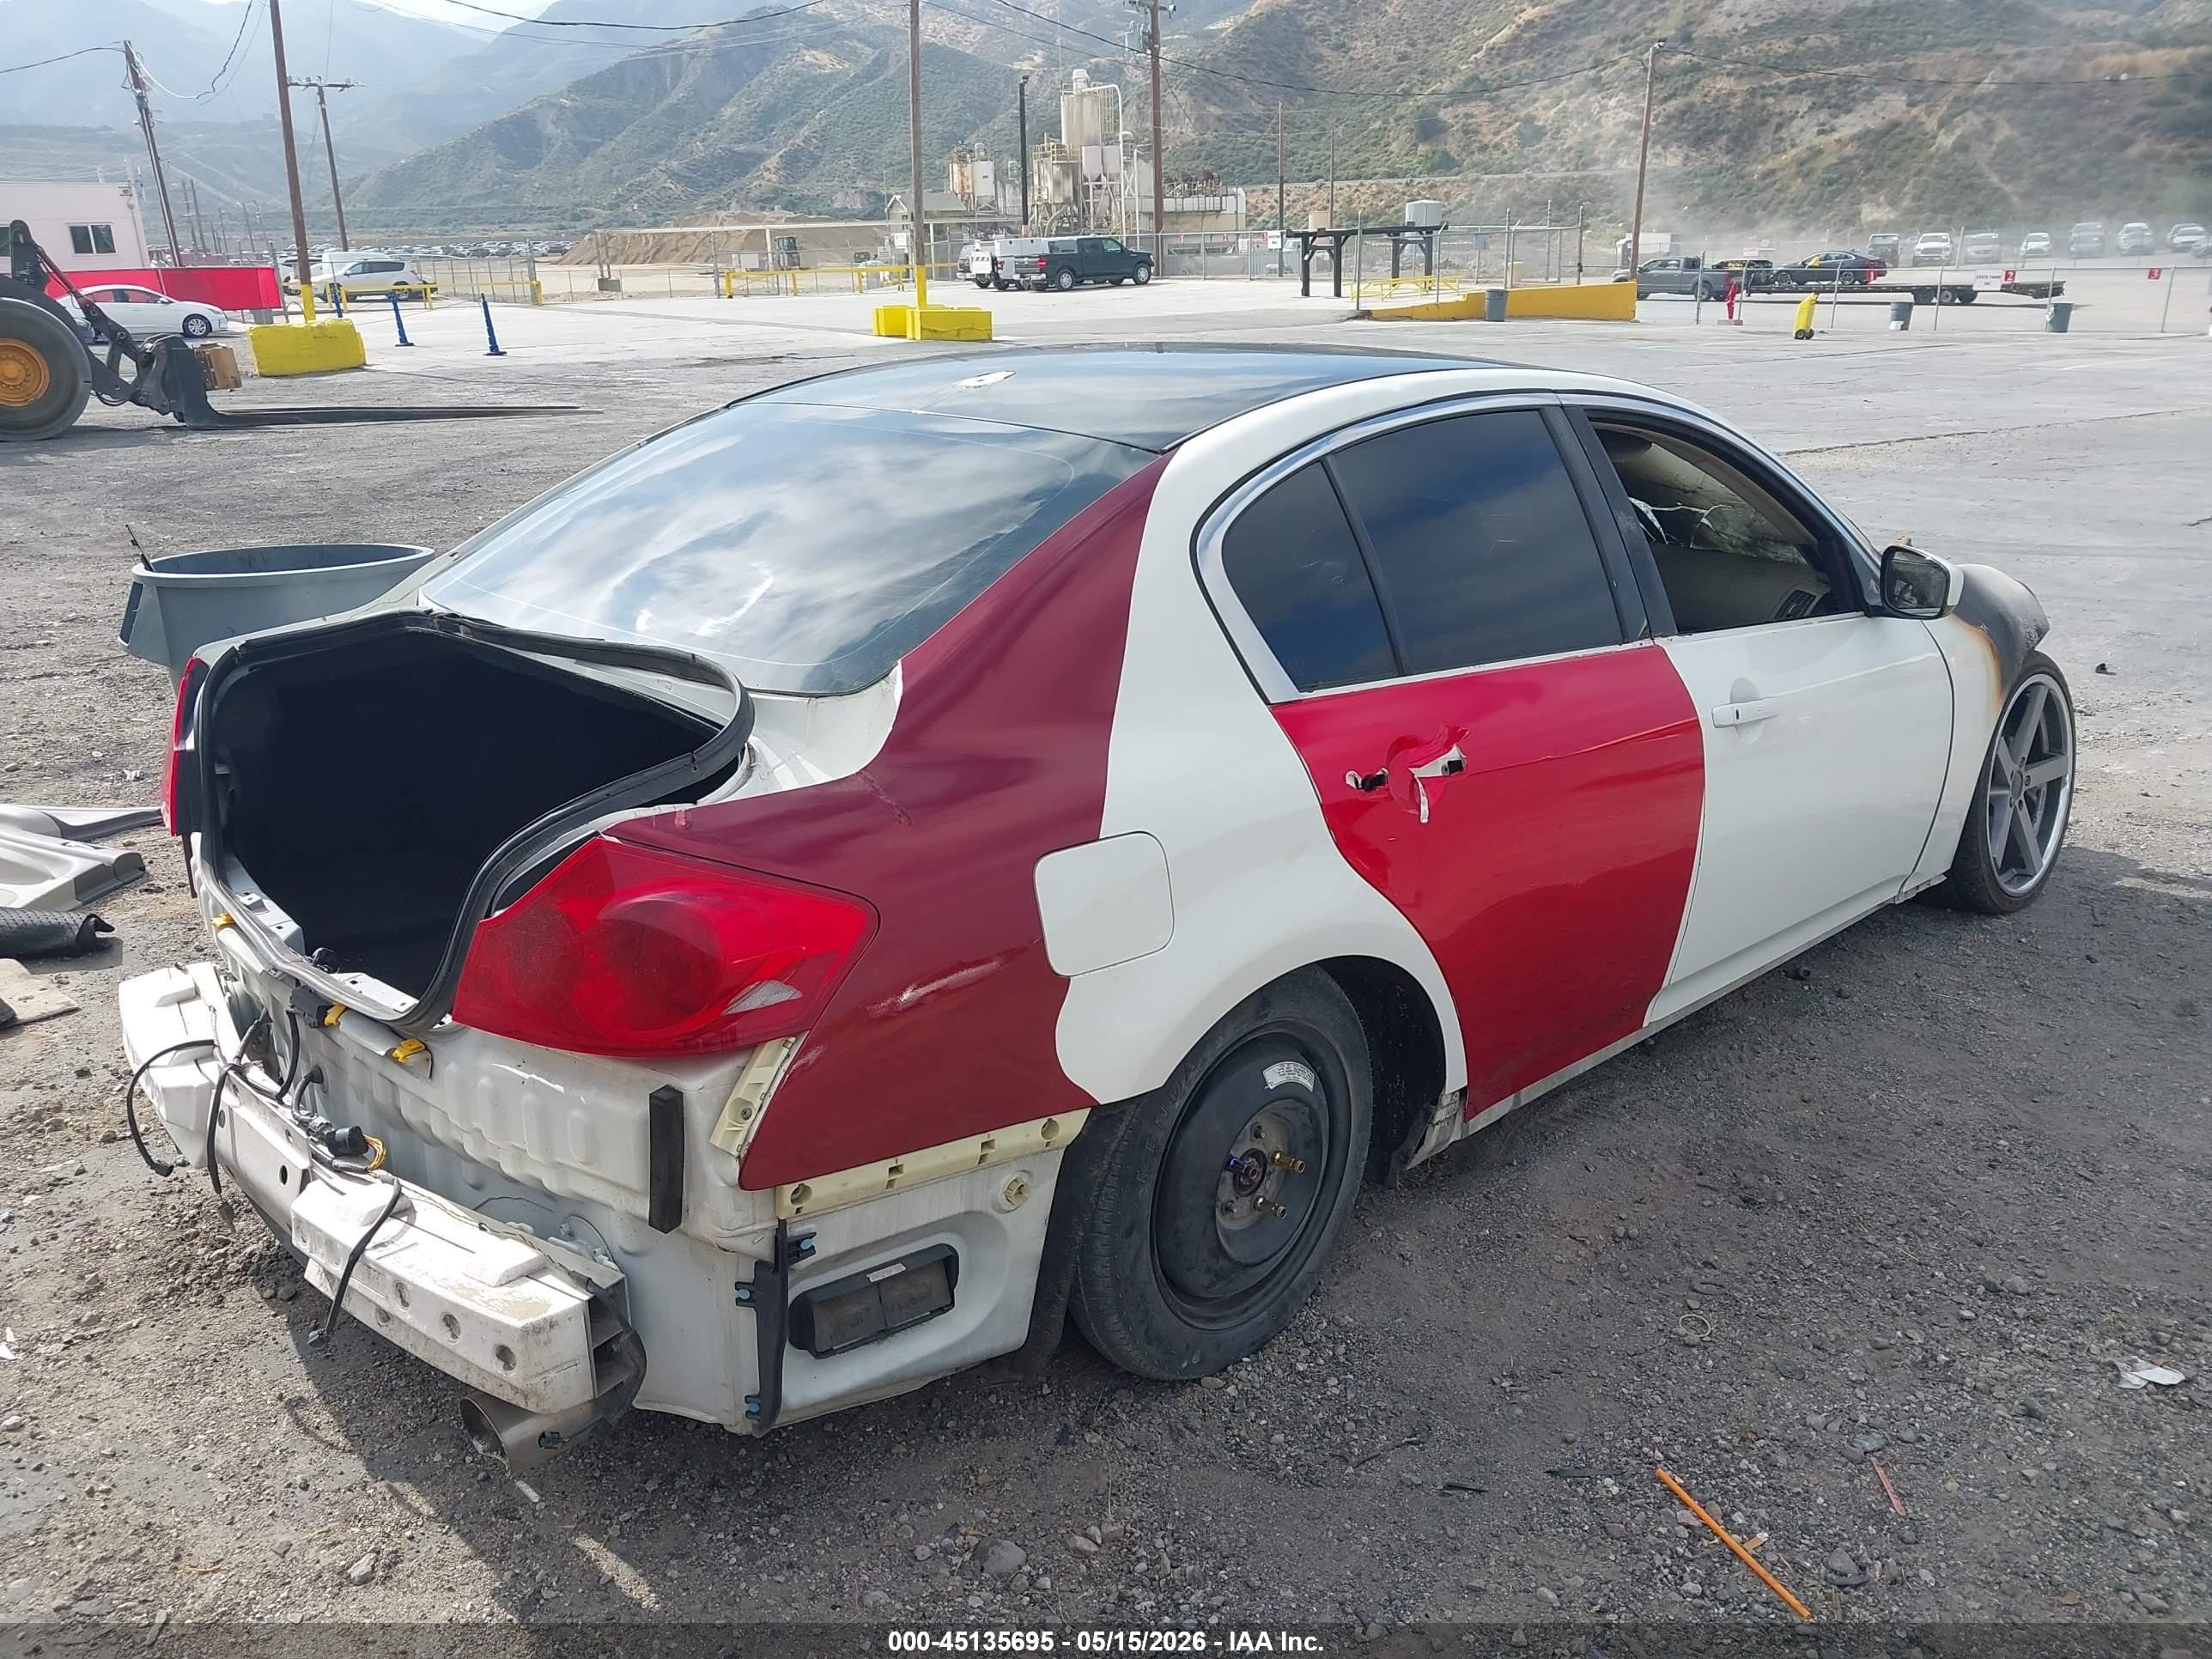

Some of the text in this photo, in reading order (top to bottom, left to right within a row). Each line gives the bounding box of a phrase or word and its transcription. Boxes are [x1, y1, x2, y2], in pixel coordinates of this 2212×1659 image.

[2007, 270, 2014, 281] 2
[2150, 269, 2159, 279] 3
[1135, 1062, 1197, 1184] KENDA
